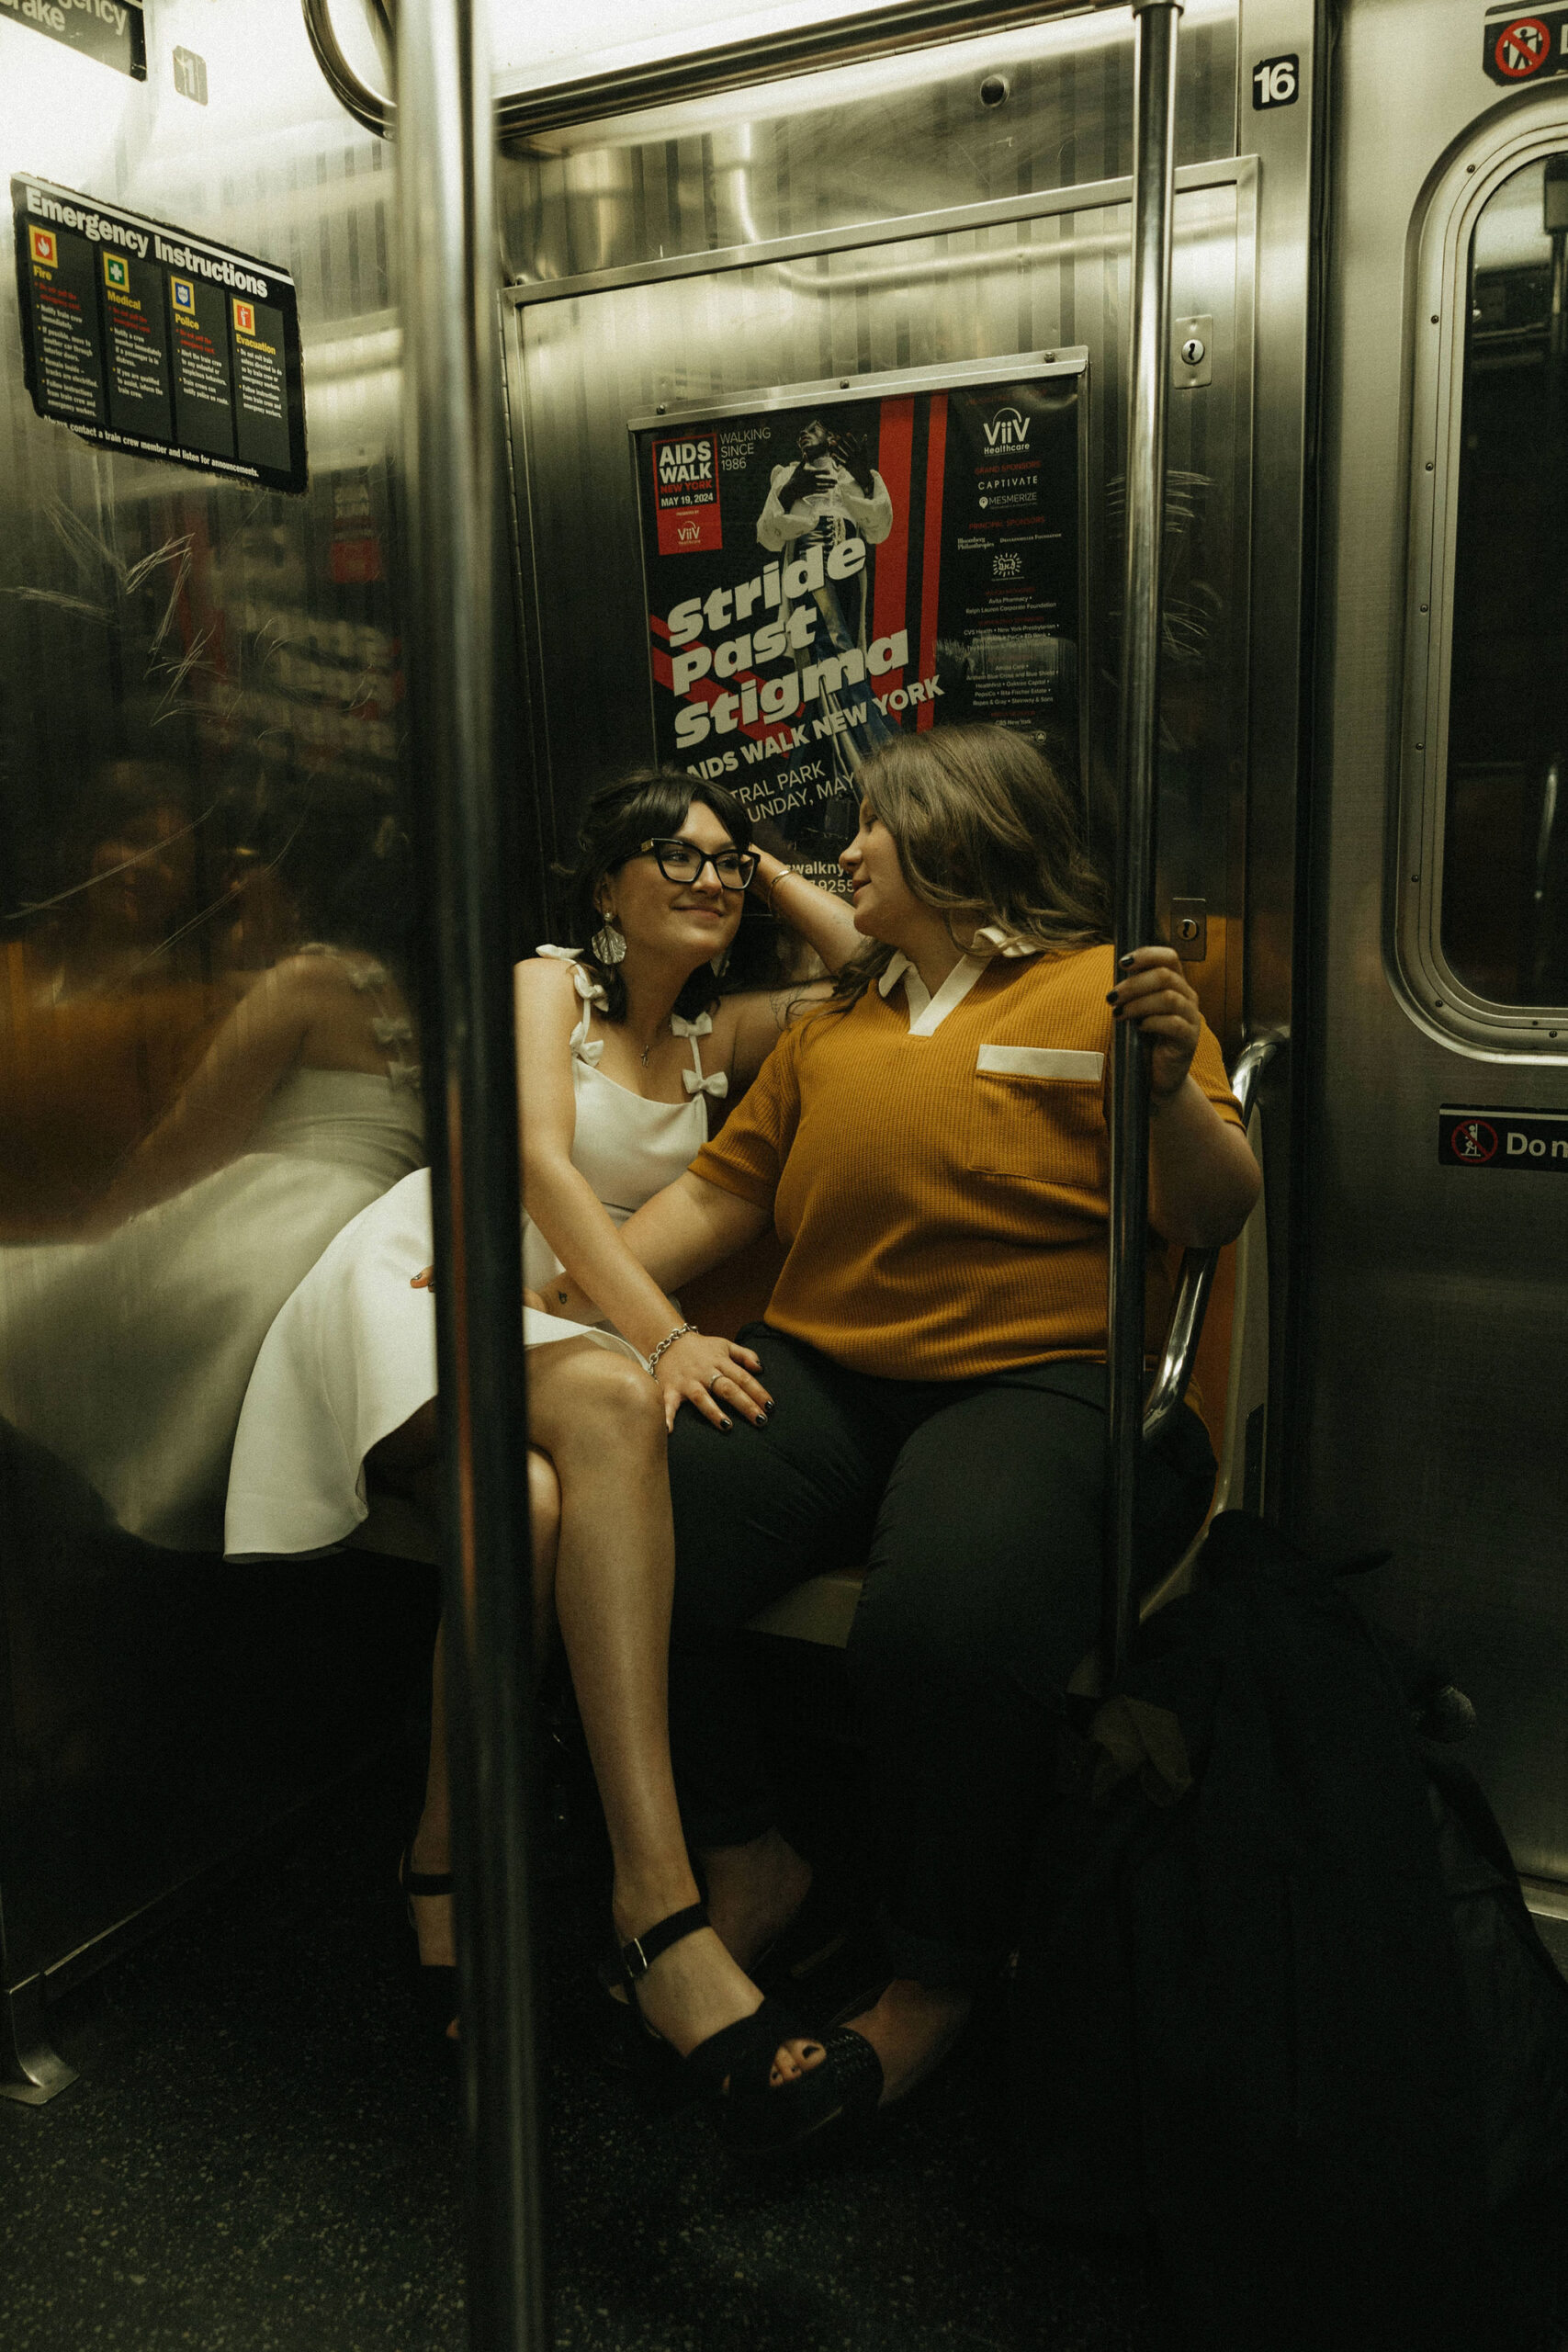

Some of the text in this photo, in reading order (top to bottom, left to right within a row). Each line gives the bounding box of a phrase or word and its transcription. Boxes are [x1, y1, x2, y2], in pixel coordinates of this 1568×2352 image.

[1254, 62, 1295, 103] 16
[26, 186, 148, 258] Emergency
[154, 234, 267, 298] Instructions
[33, 265, 52, 281] Fire
[107, 290, 141, 311] Medical
[175, 312, 199, 331] Police
[235, 333, 276, 356] Evacuation
[719, 426, 772, 445] WALKING
[983, 417, 1031, 446] ViiV
[70, 424, 96, 437] contact
[105, 430, 121, 443] train
[123, 437, 140, 447] crew
[141, 441, 167, 454] member
[169, 448, 181, 458] and
[182, 449, 199, 462] listen
[201, 454, 210, 465] for
[211, 458, 259, 478] announcements.
[659, 440, 712, 468] AIDS
[720, 442, 754, 458] SINCE
[984, 443, 1030, 455] Healthcare
[660, 461, 713, 484] WALK
[721, 457, 747, 471] 1986
[975, 460, 1042, 475] GRAND SPONSORS
[660, 480, 713, 493] NEW YORK
[978, 475, 1038, 491] CAPTIVATE
[660, 492, 714, 507] MAY 19, 2024
[988, 492, 1037, 505] MESMERIZE
[1006, 516, 1044, 526] SPONSORS
[677, 526, 700, 541] ViiV
[668, 537, 866, 648] Stride
[671, 604, 818, 696] Past
[674, 628, 909, 750] Stigma
[740, 725, 811, 764] WALK
[812, 702, 868, 737] NEW
[872, 674, 945, 717] YORK
[777, 760, 826, 791] PARK
[747, 773, 854, 822] UNDAY, MAY
[1506, 1132, 1547, 1157] Do
